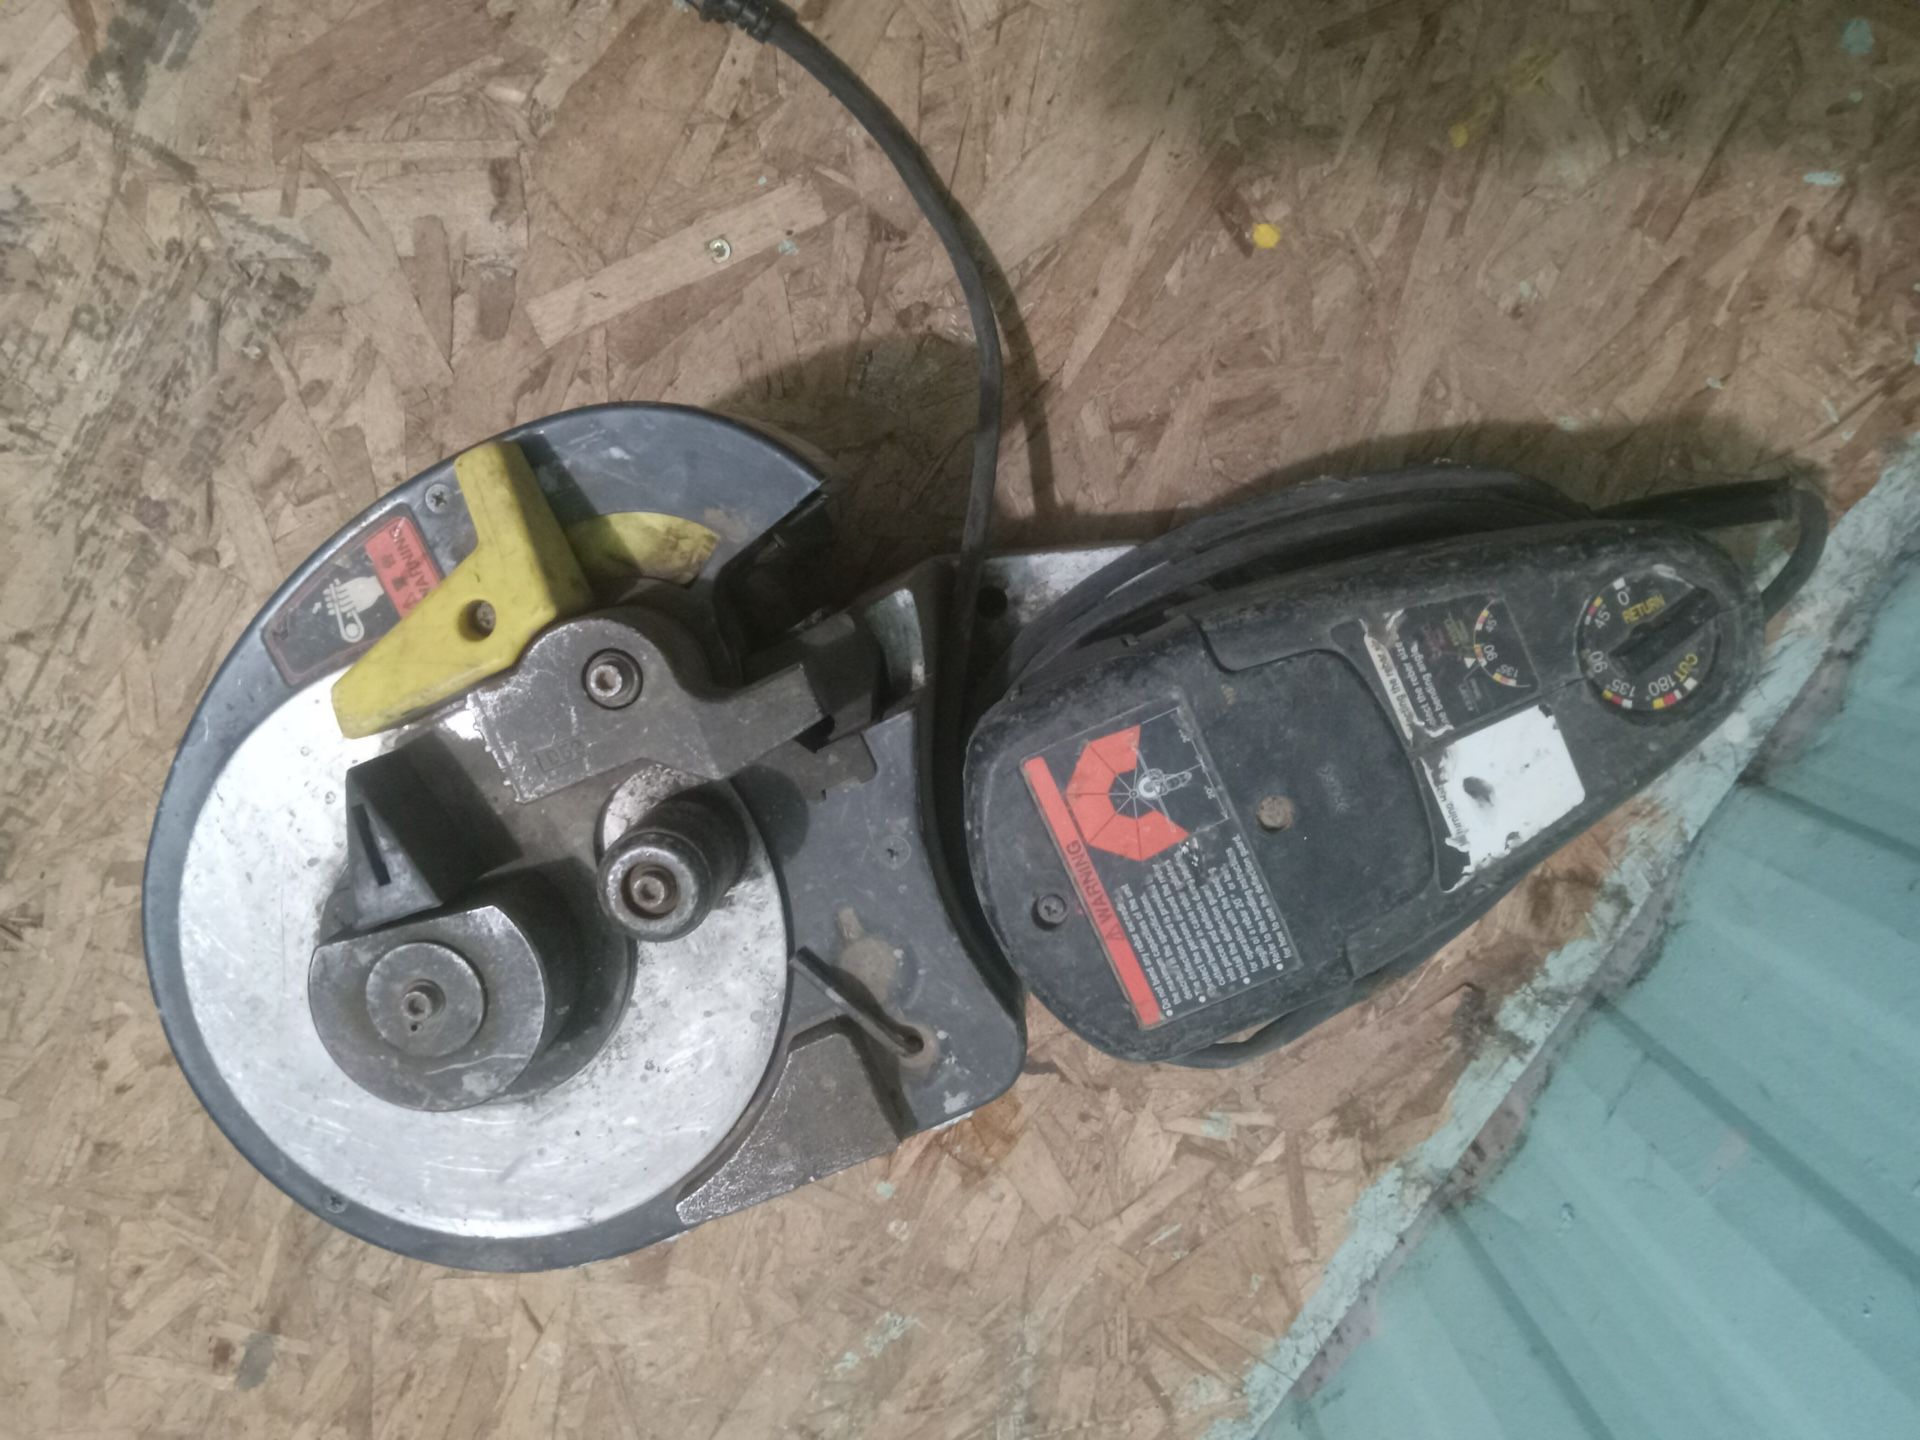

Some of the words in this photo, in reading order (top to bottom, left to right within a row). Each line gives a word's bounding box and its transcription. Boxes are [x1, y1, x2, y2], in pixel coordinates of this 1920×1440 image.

[1622, 594, 1665, 624] RETURN
[1674, 653, 1698, 682] CUT
[1412, 685, 1427, 703] the
[1420, 672, 1445, 712] bending
[1223, 846, 1250, 890] instructions
[1240, 856, 1264, 895] deflection
[1066, 839, 1112, 925] WARNING
[1120, 882, 1133, 899] unit
[1159, 882, 1172, 897] the
[1226, 880, 1236, 891] or
[1127, 897, 1139, 911] the
[1165, 895, 1184, 923] around
[1218, 895, 1231, 910] the
[1241, 887, 1265, 921] handling
[1257, 893, 1270, 908] the
[1132, 910, 1143, 921] of
[1161, 915, 1171, 924] is
[1186, 909, 1201, 930] case
[1224, 908, 1238, 926] with
[1237, 908, 1253, 930] rebar
[1263, 906, 1277, 922] use
[1208, 904, 1233, 943] deflection
[1255, 919, 1269, 934] the
[1269, 920, 1280, 931] to
[1137, 918, 1162, 958] capacities
[1165, 922, 1182, 945] guard
[1177, 920, 1198, 951] persons
[1194, 928, 1204, 938] in
[1207, 928, 1220, 945] and
[1249, 934, 1261, 946] of
[1261, 932, 1272, 943] to
[1273, 929, 1288, 947] how
[1130, 932, 1145, 953] rebar
[1160, 943, 1173, 958] the
[1225, 941, 1238, 955] the
[1232, 924, 1255, 961] operation
[1140, 951, 1153, 967] any
[1190, 950, 1202, 964] the
[1214, 942, 1232, 968] pieces
[1252, 943, 1272, 969] length
[1264, 941, 1282, 964] Refer
[1280, 945, 1292, 959] for
[1174, 943, 1197, 981] deflection
[1231, 953, 1248, 978] Install
[1247, 959, 1259, 973] for
[1145, 966, 1160, 986] bend
[1155, 956, 1176, 992] maximum
[1224, 966, 1237, 982] into
[1154, 984, 1166, 999] not
[1170, 990, 1182, 1005] the
[1159, 997, 1171, 1010] Do
